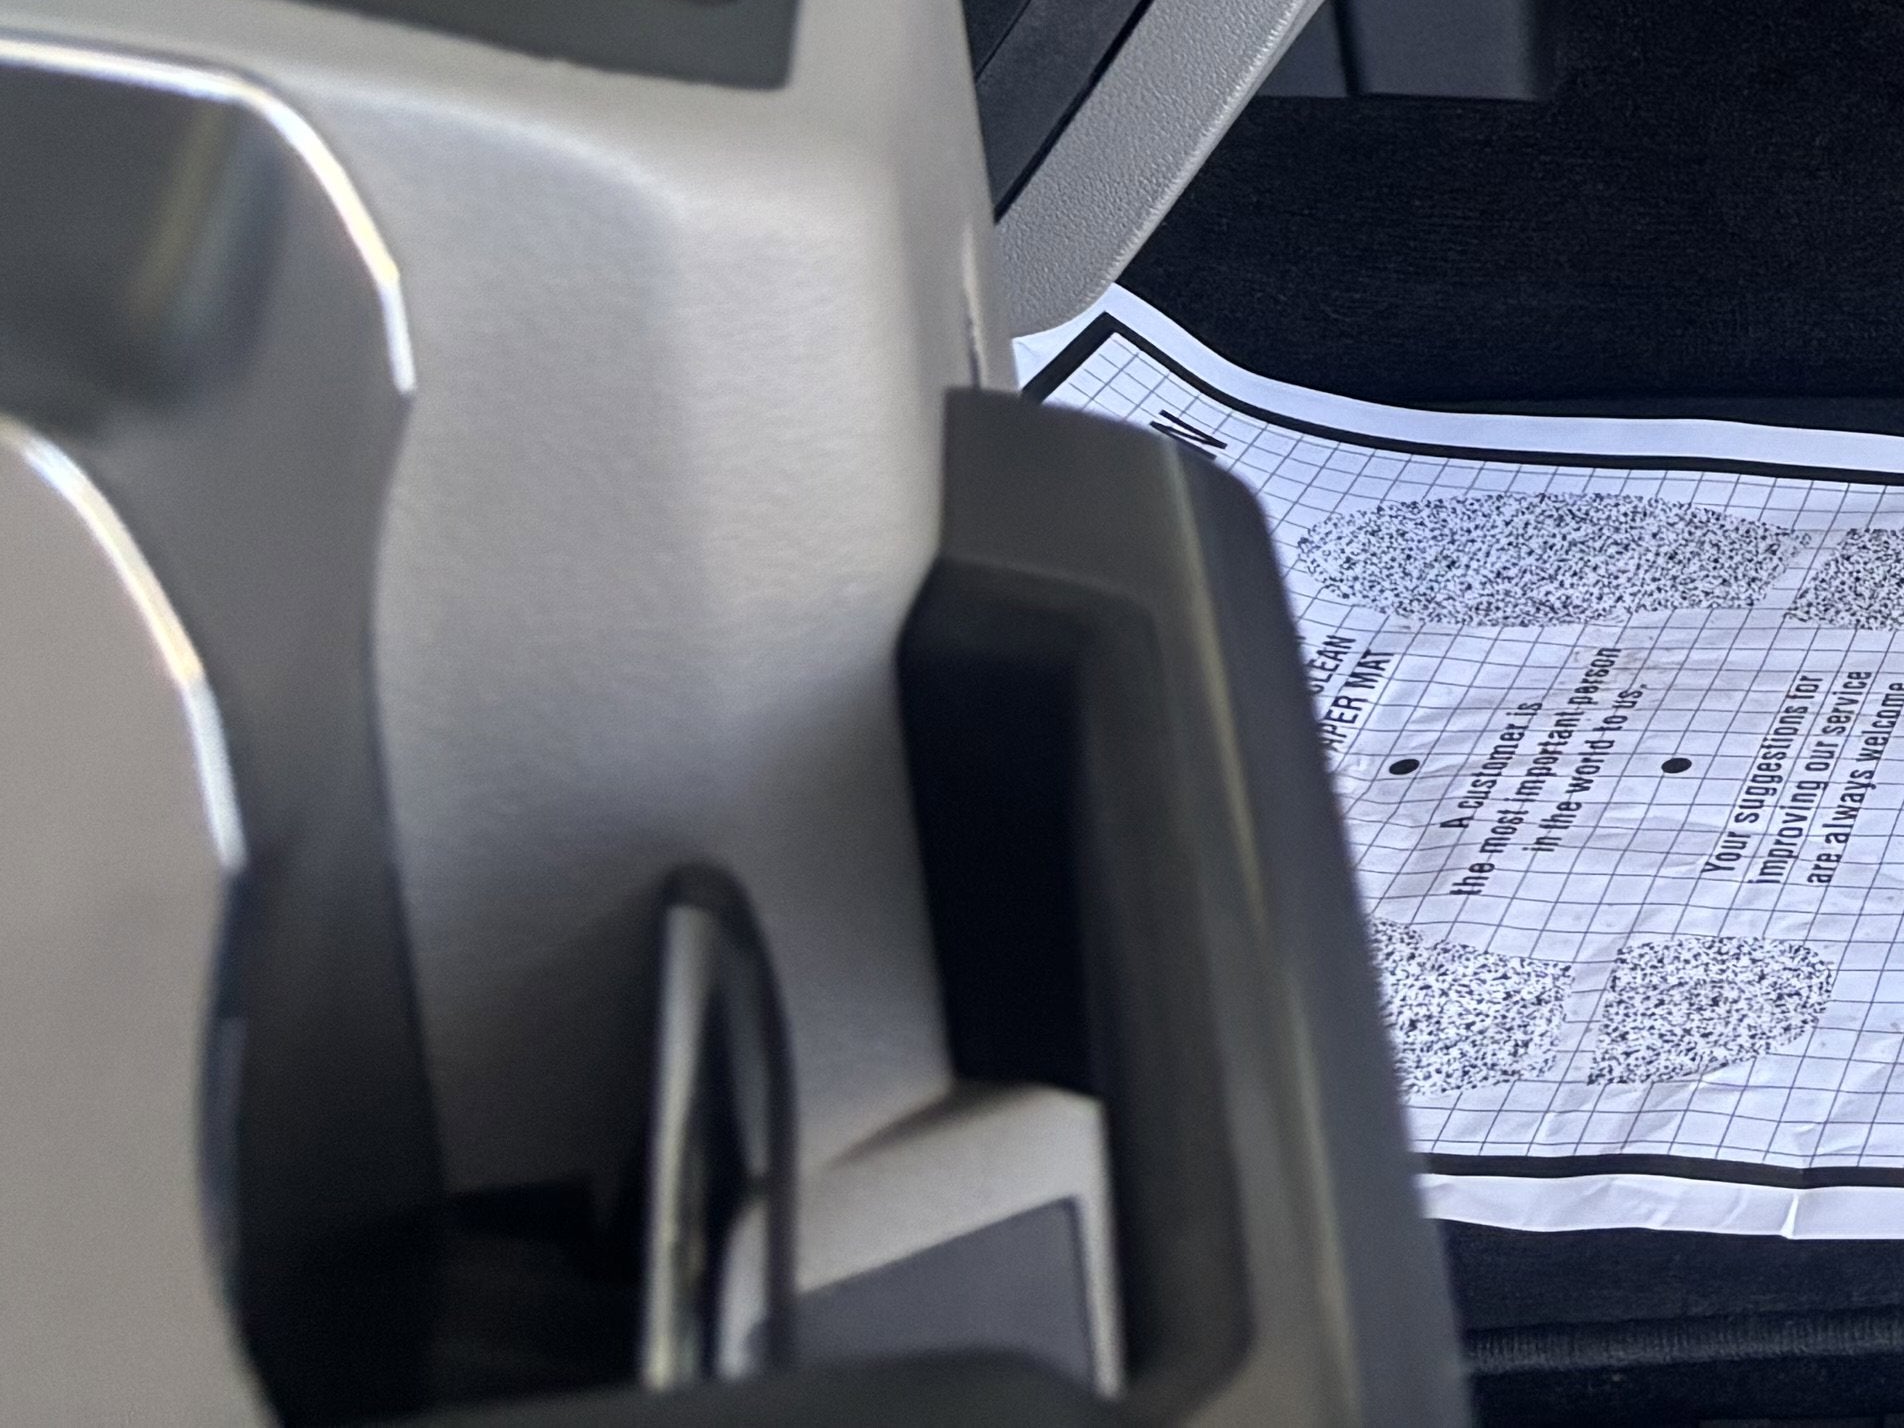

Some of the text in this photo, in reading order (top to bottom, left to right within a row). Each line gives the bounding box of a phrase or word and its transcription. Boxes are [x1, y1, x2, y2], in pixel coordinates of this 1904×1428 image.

[1343, 649, 1394, 689] MAT
[1593, 714, 1628, 732] to
[1440, 702, 1542, 828] A customer is
[1450, 647, 1622, 895] the most important person
[1565, 739, 1615, 794] world
[1701, 675, 1823, 873] Your suggestions for
[1748, 671, 1872, 884] improving our service
[1539, 801, 1582, 829] the
[1822, 769, 1877, 844] always
[1522, 836, 1562, 852] in
[1807, 853, 1841, 883] are
